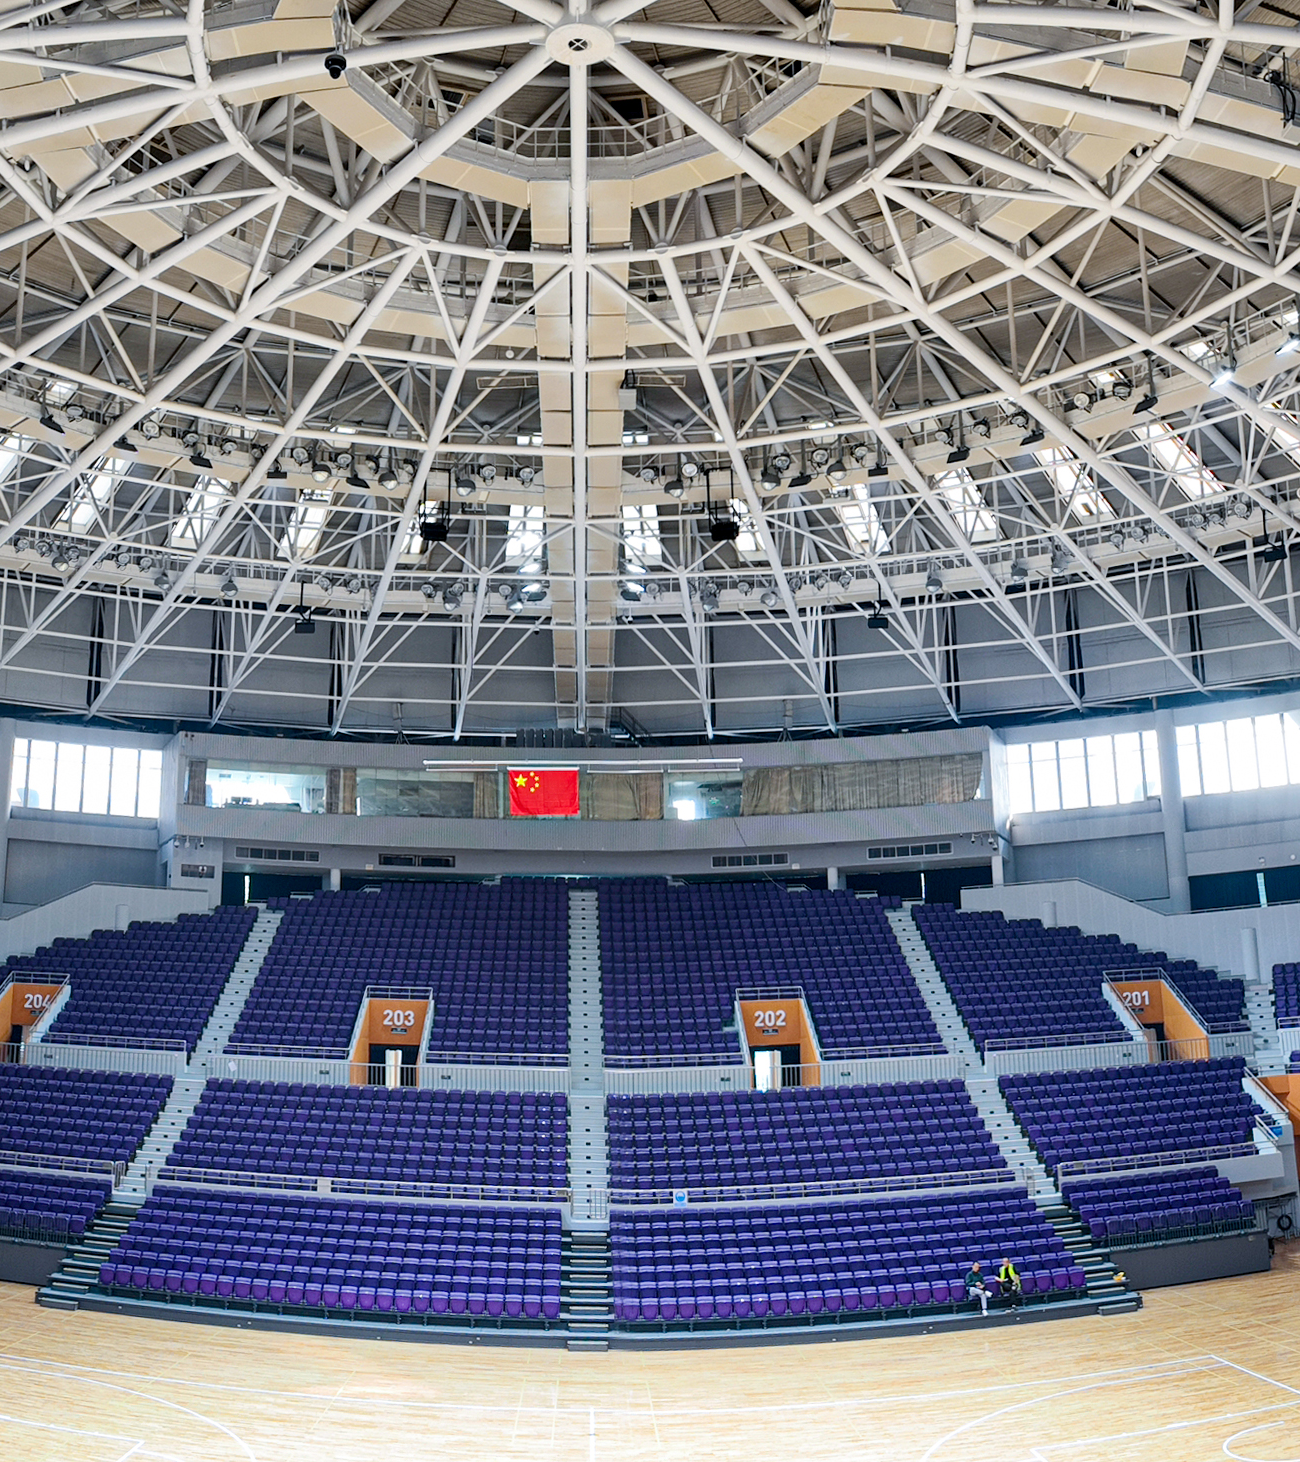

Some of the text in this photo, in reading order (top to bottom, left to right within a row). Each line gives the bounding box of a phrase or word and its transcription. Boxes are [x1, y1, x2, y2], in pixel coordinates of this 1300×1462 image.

[23, 993, 51, 1009] 204
[1122, 990, 1150, 1007] 201
[383, 1009, 415, 1027] 203
[754, 1009, 787, 1027] 202
